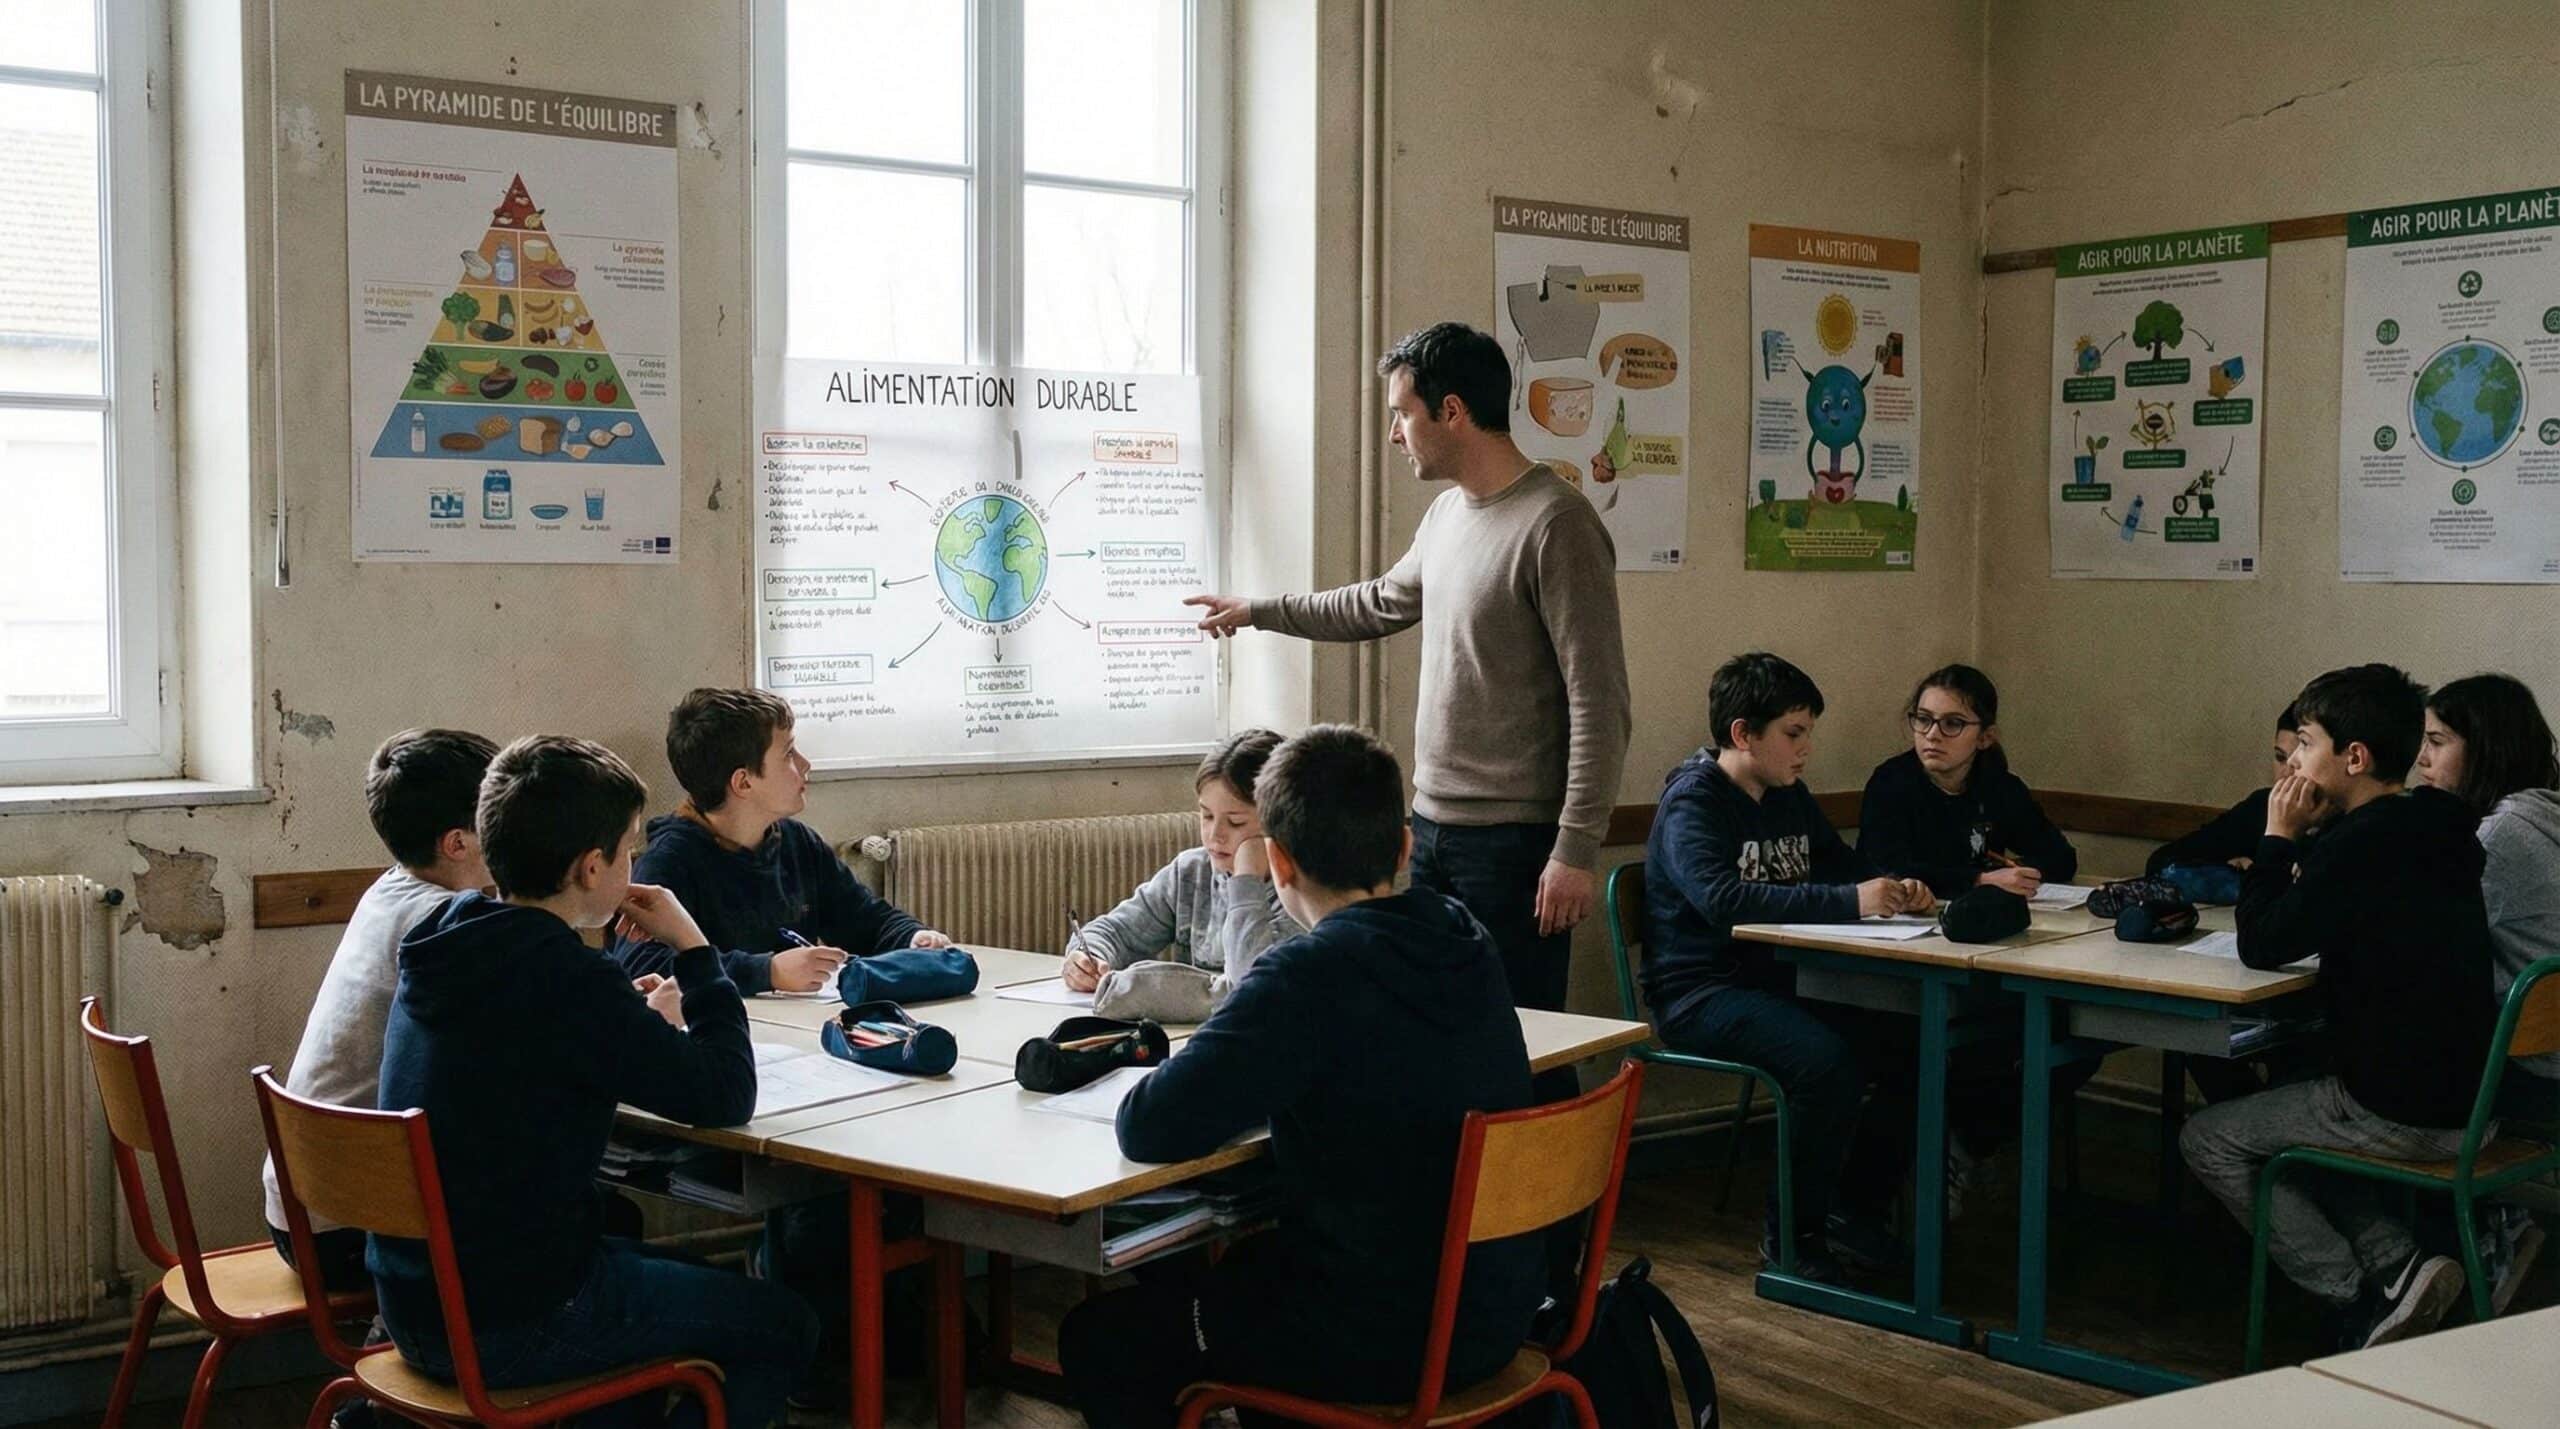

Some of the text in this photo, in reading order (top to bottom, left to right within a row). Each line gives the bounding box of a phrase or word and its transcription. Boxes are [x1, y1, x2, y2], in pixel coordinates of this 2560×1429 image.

[360, 82, 663, 137] LA PYRAMIDE DE L'ÉQUILIBRE
[1502, 205, 1682, 243] LA PYRAMIDE DE L'ÉQUILIBRE
[2370, 213, 2410, 239] AGIR
[2415, 208, 2462, 234] POUR
[2467, 204, 2490, 228] LA
[1798, 236, 1878, 262] LA NUTRITION
[2077, 231, 2244, 271] AGIR POUR LA PLANÈTE
[1037, 378, 1138, 412] DURABLE
